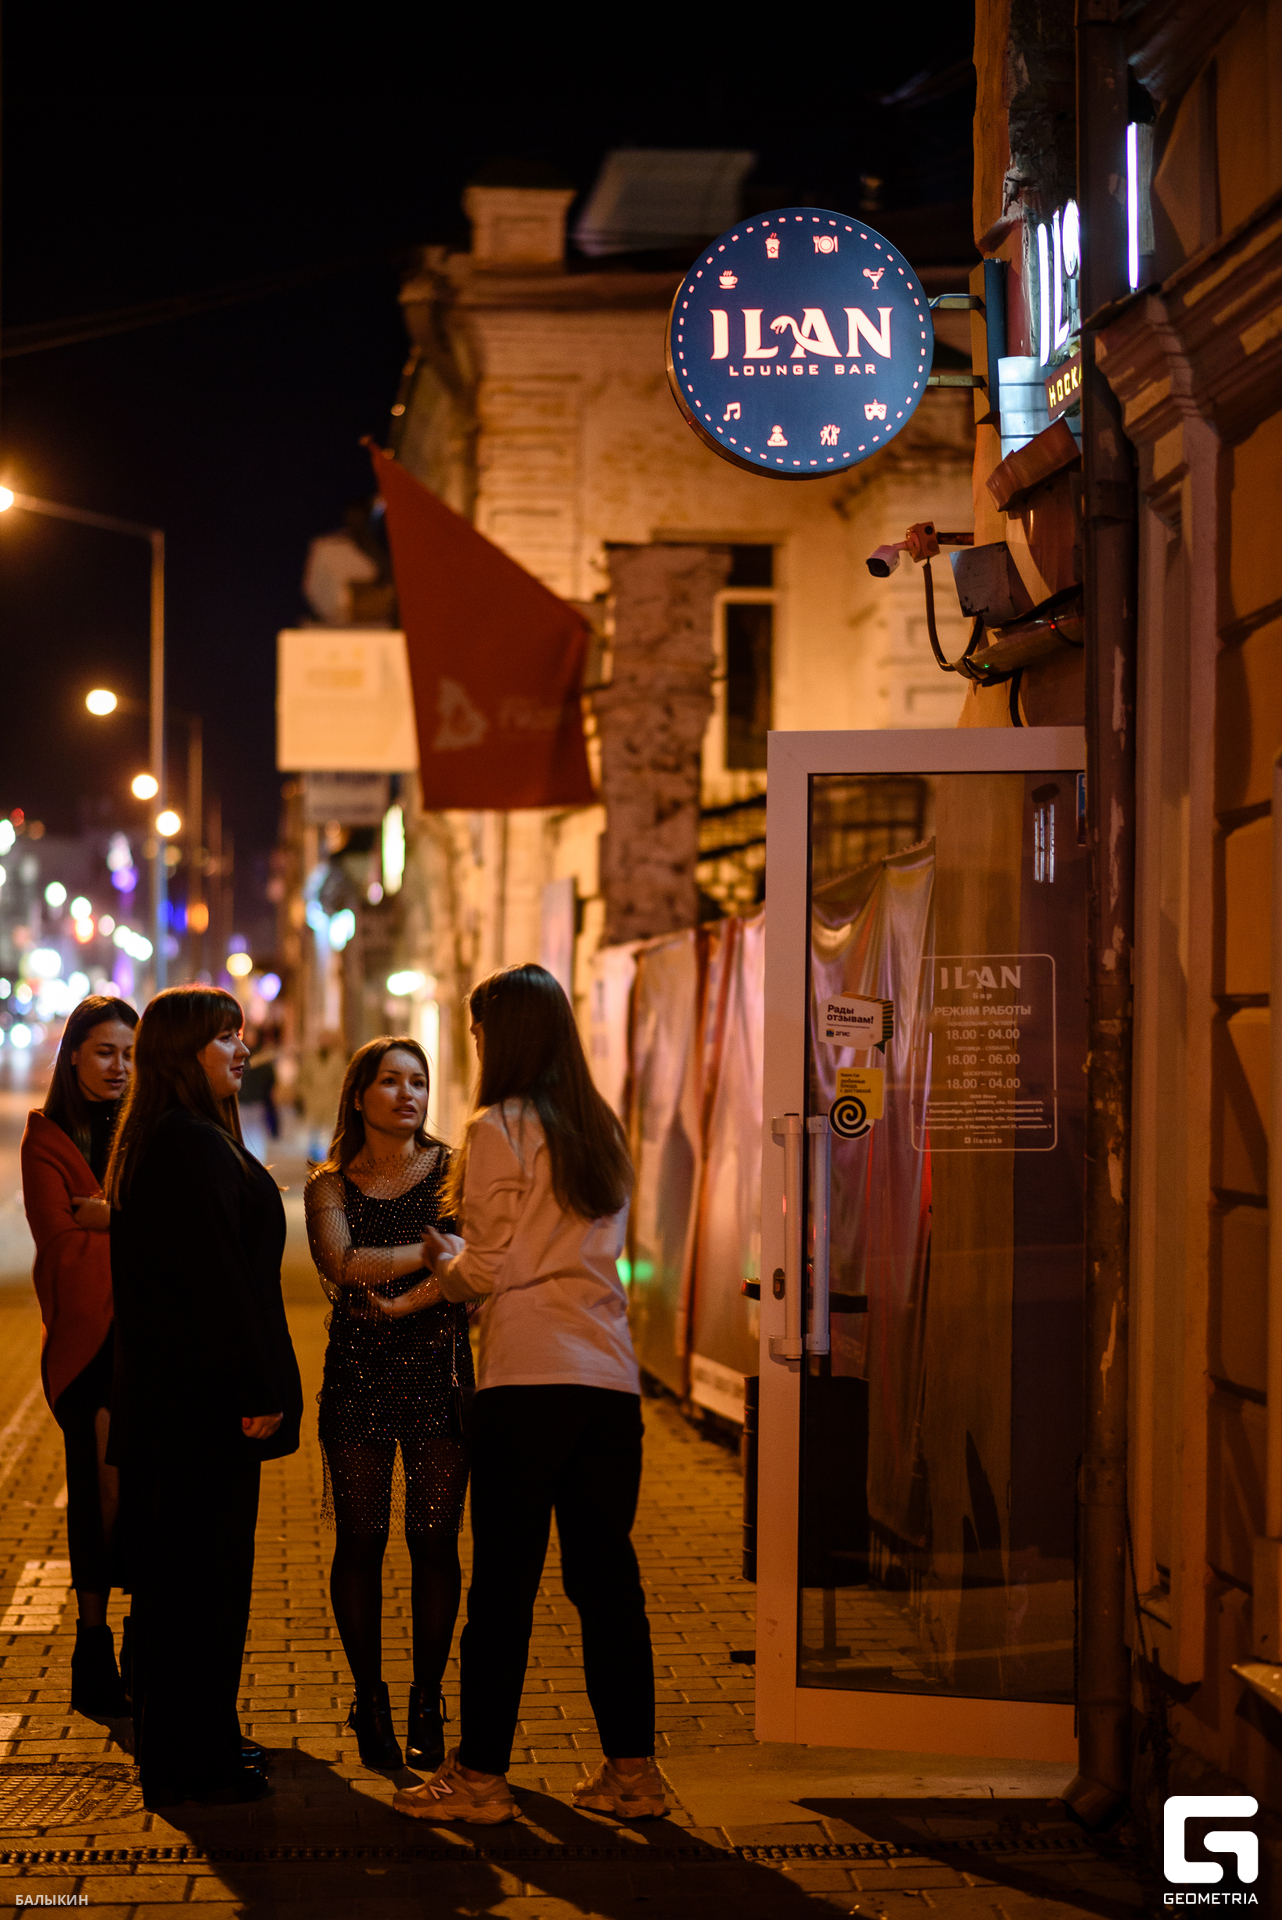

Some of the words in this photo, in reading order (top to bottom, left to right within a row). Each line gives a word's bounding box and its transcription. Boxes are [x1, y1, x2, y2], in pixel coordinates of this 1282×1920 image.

[709, 306, 894, 360] ILAN
[729, 364, 820, 377] LOUNGE
[834, 363, 877, 376] BAR
[940, 965, 1021, 990] ILAN
[827, 1004, 854, 1015] Рады
[934, 1006, 980, 1017] РЕЖИМ
[982, 1005, 1032, 1016] РАБОТЫ
[826, 1013, 874, 1025] отзывам!
[946, 1030, 977, 1040] 18.00
[988, 1029, 1020, 1039] 04.00
[946, 1054, 977, 1065] 18.00
[988, 1054, 1020, 1064] 06.00
[946, 1079, 978, 1089] 18.00
[988, 1078, 1021, 1088] 04.00
